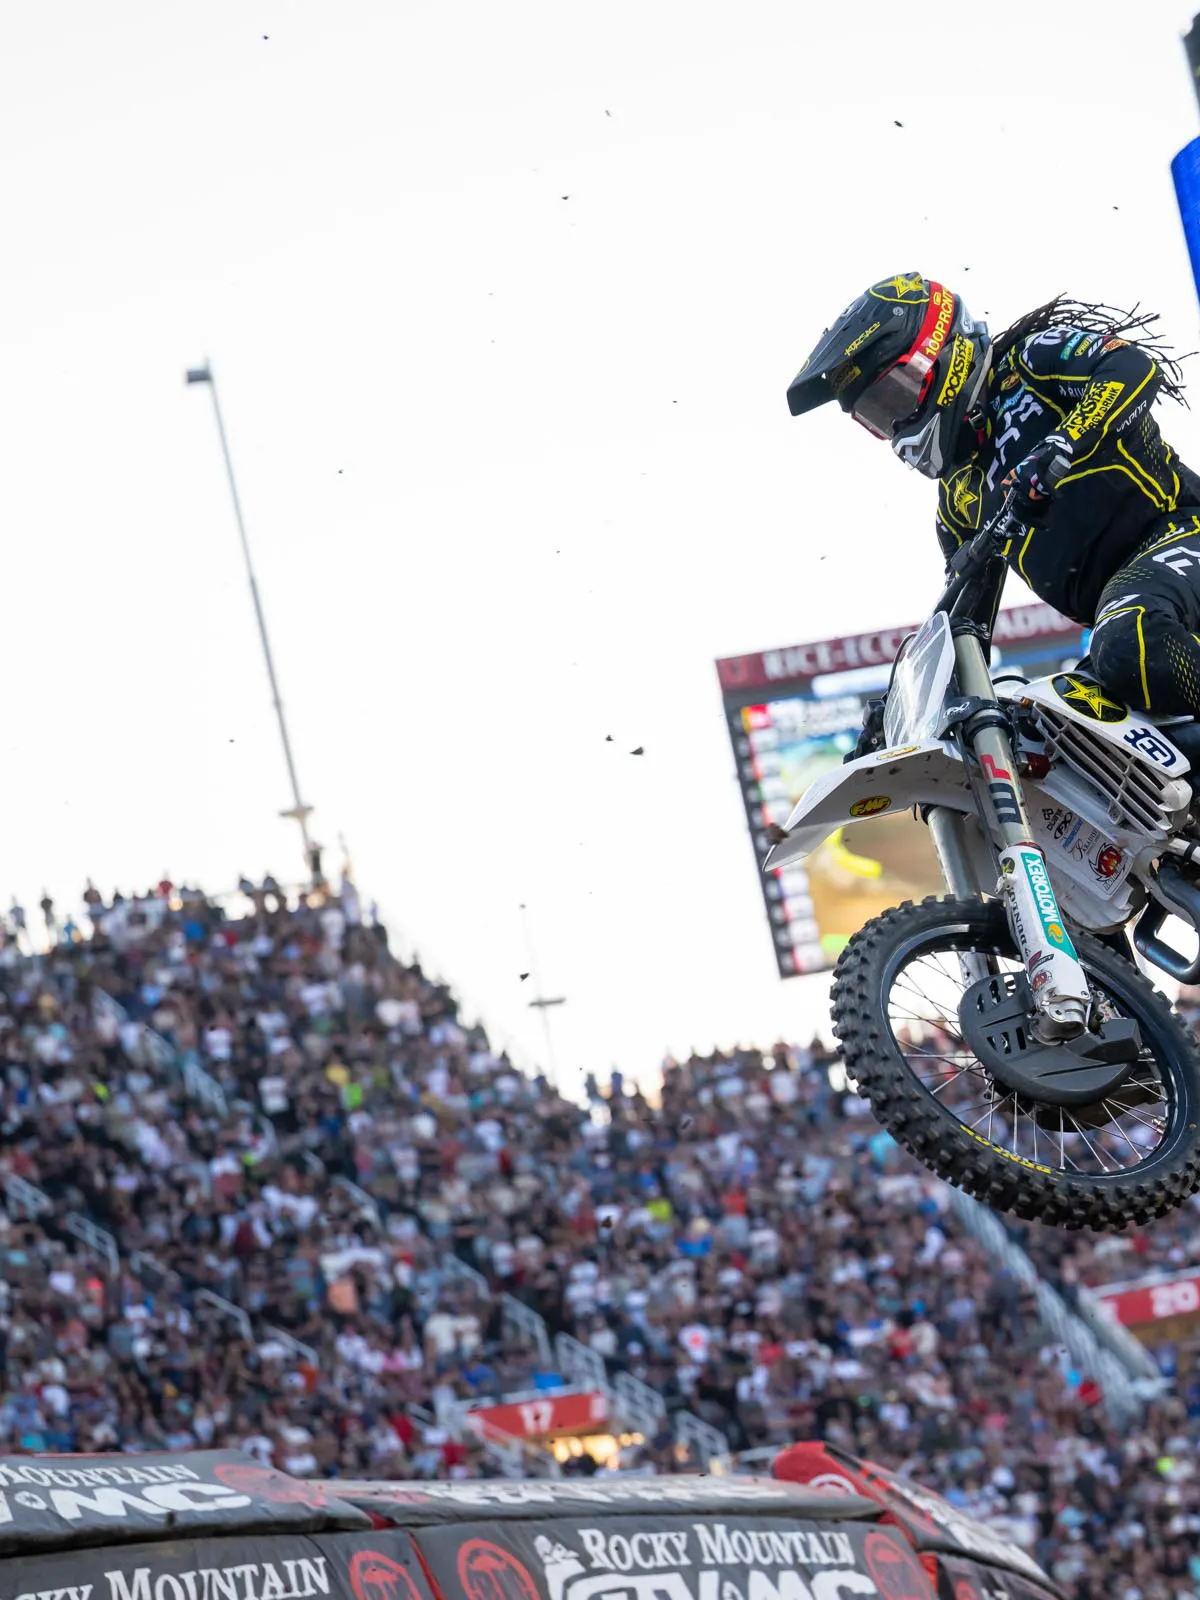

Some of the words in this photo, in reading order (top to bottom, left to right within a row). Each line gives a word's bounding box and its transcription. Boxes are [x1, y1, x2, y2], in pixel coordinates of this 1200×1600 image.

[925, 287, 954, 357] 100PRCNT
[941, 333, 968, 407] ROCKSTAR
[1099, 385, 1120, 413] DRINK
[1008, 887, 1027, 946] DUNLO
[1026, 856, 1059, 923] MOTOREX
[578, 1528, 692, 1571] ROCKY
[692, 1523, 856, 1566] MOUNTAIN
